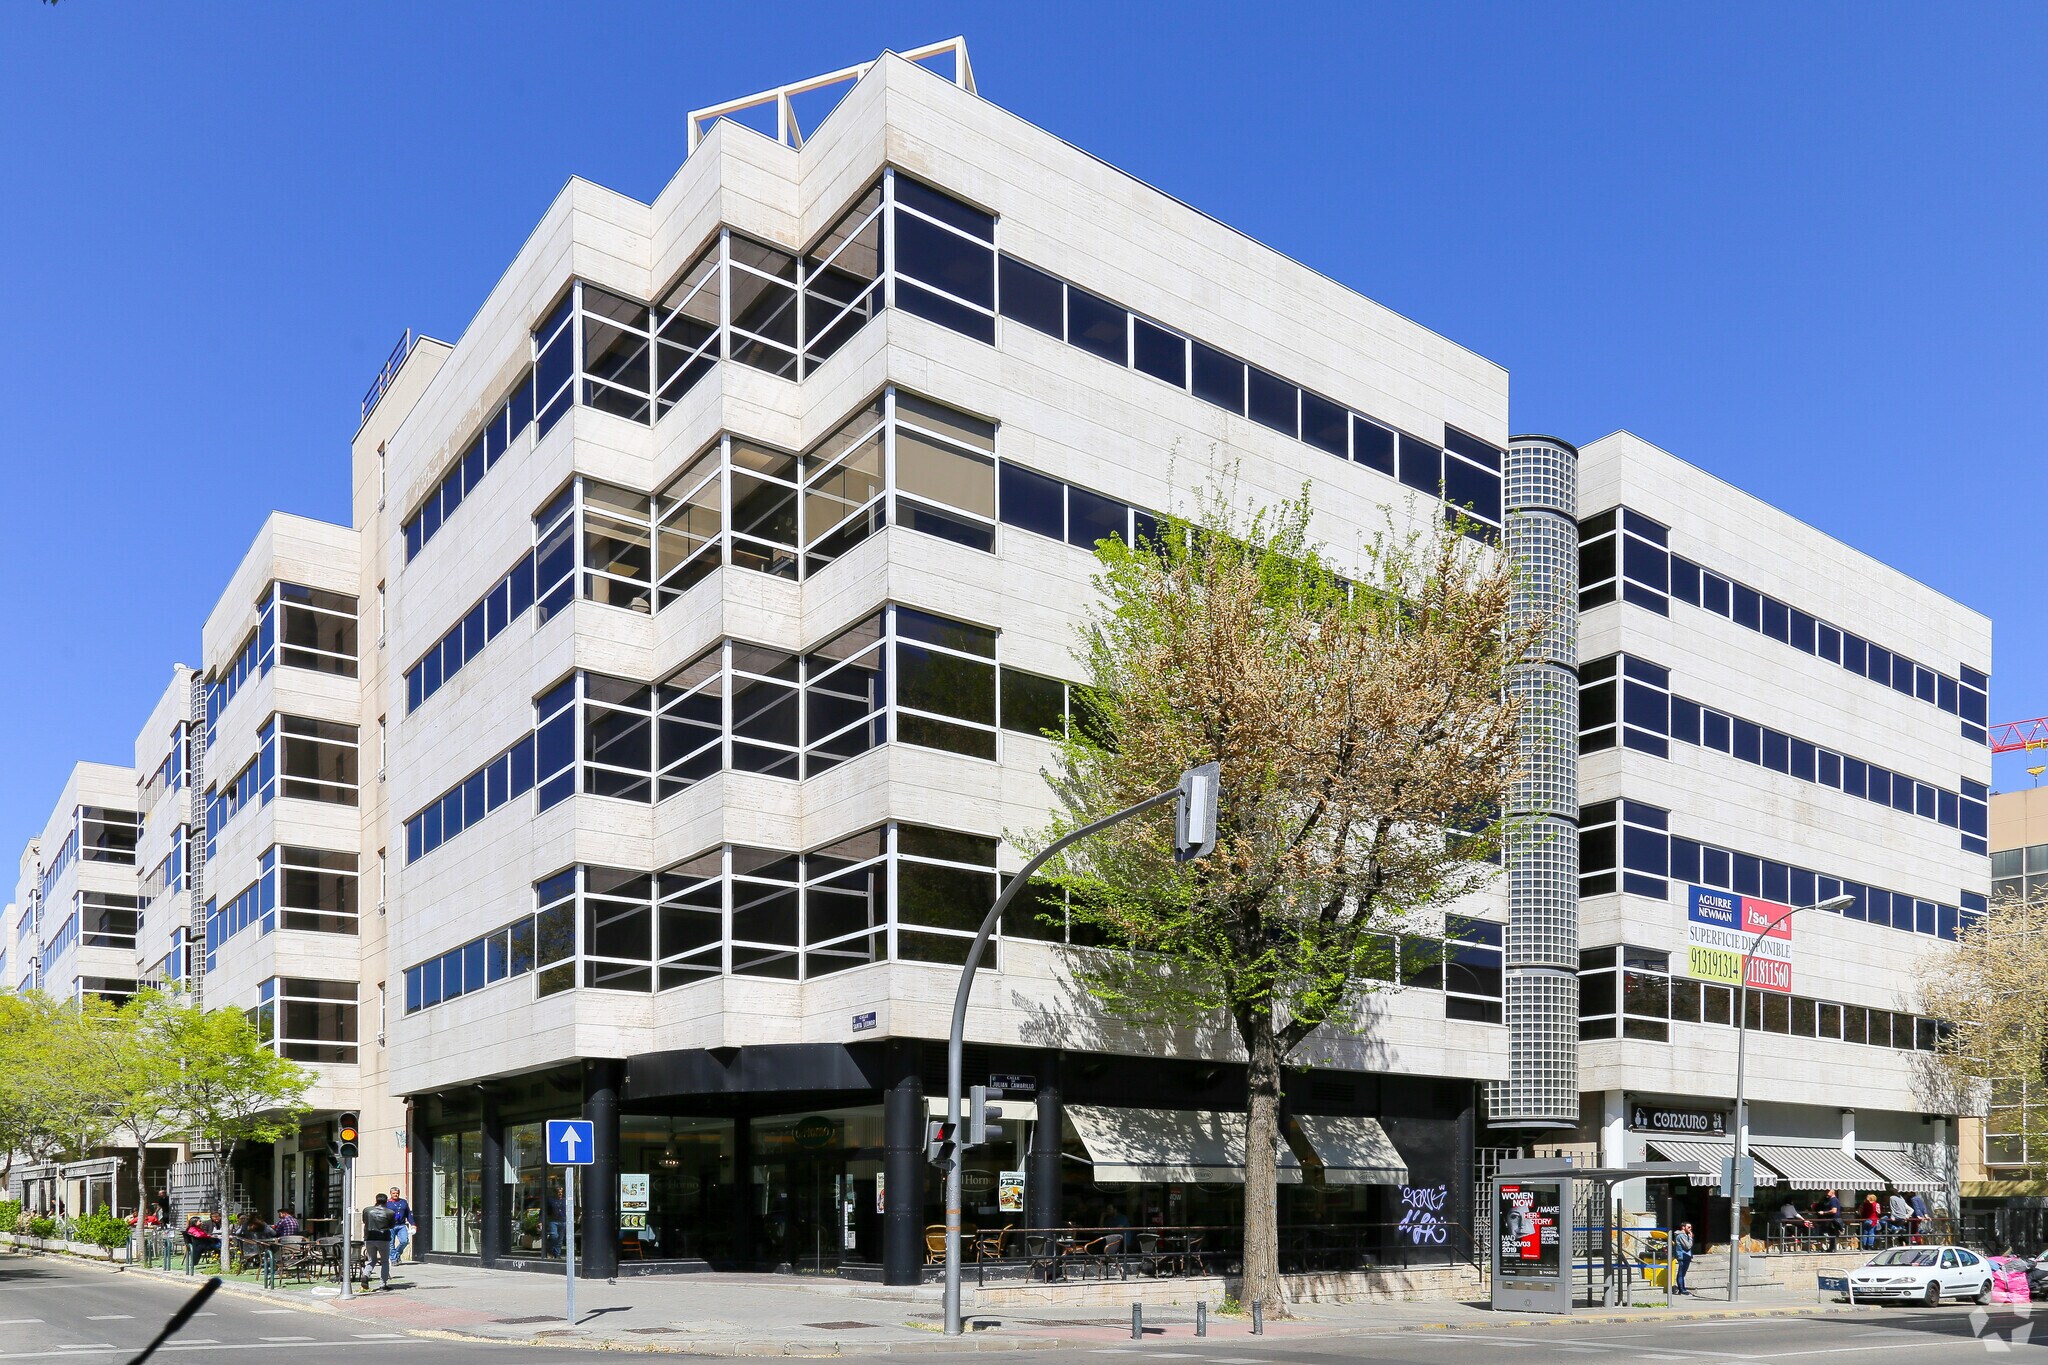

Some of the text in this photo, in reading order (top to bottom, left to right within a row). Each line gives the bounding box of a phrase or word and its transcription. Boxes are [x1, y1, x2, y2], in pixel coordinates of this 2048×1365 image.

[1698, 893, 1732, 909] AGUIRRE
[1698, 907, 1732, 922] NEWMAN
[1689, 925, 1740, 949] SUPERFICIE
[1691, 947, 1739, 979] 913191314
[1501, 1192, 1534, 1200] WOMEN
[1512, 1199, 1534, 1207] NOW
